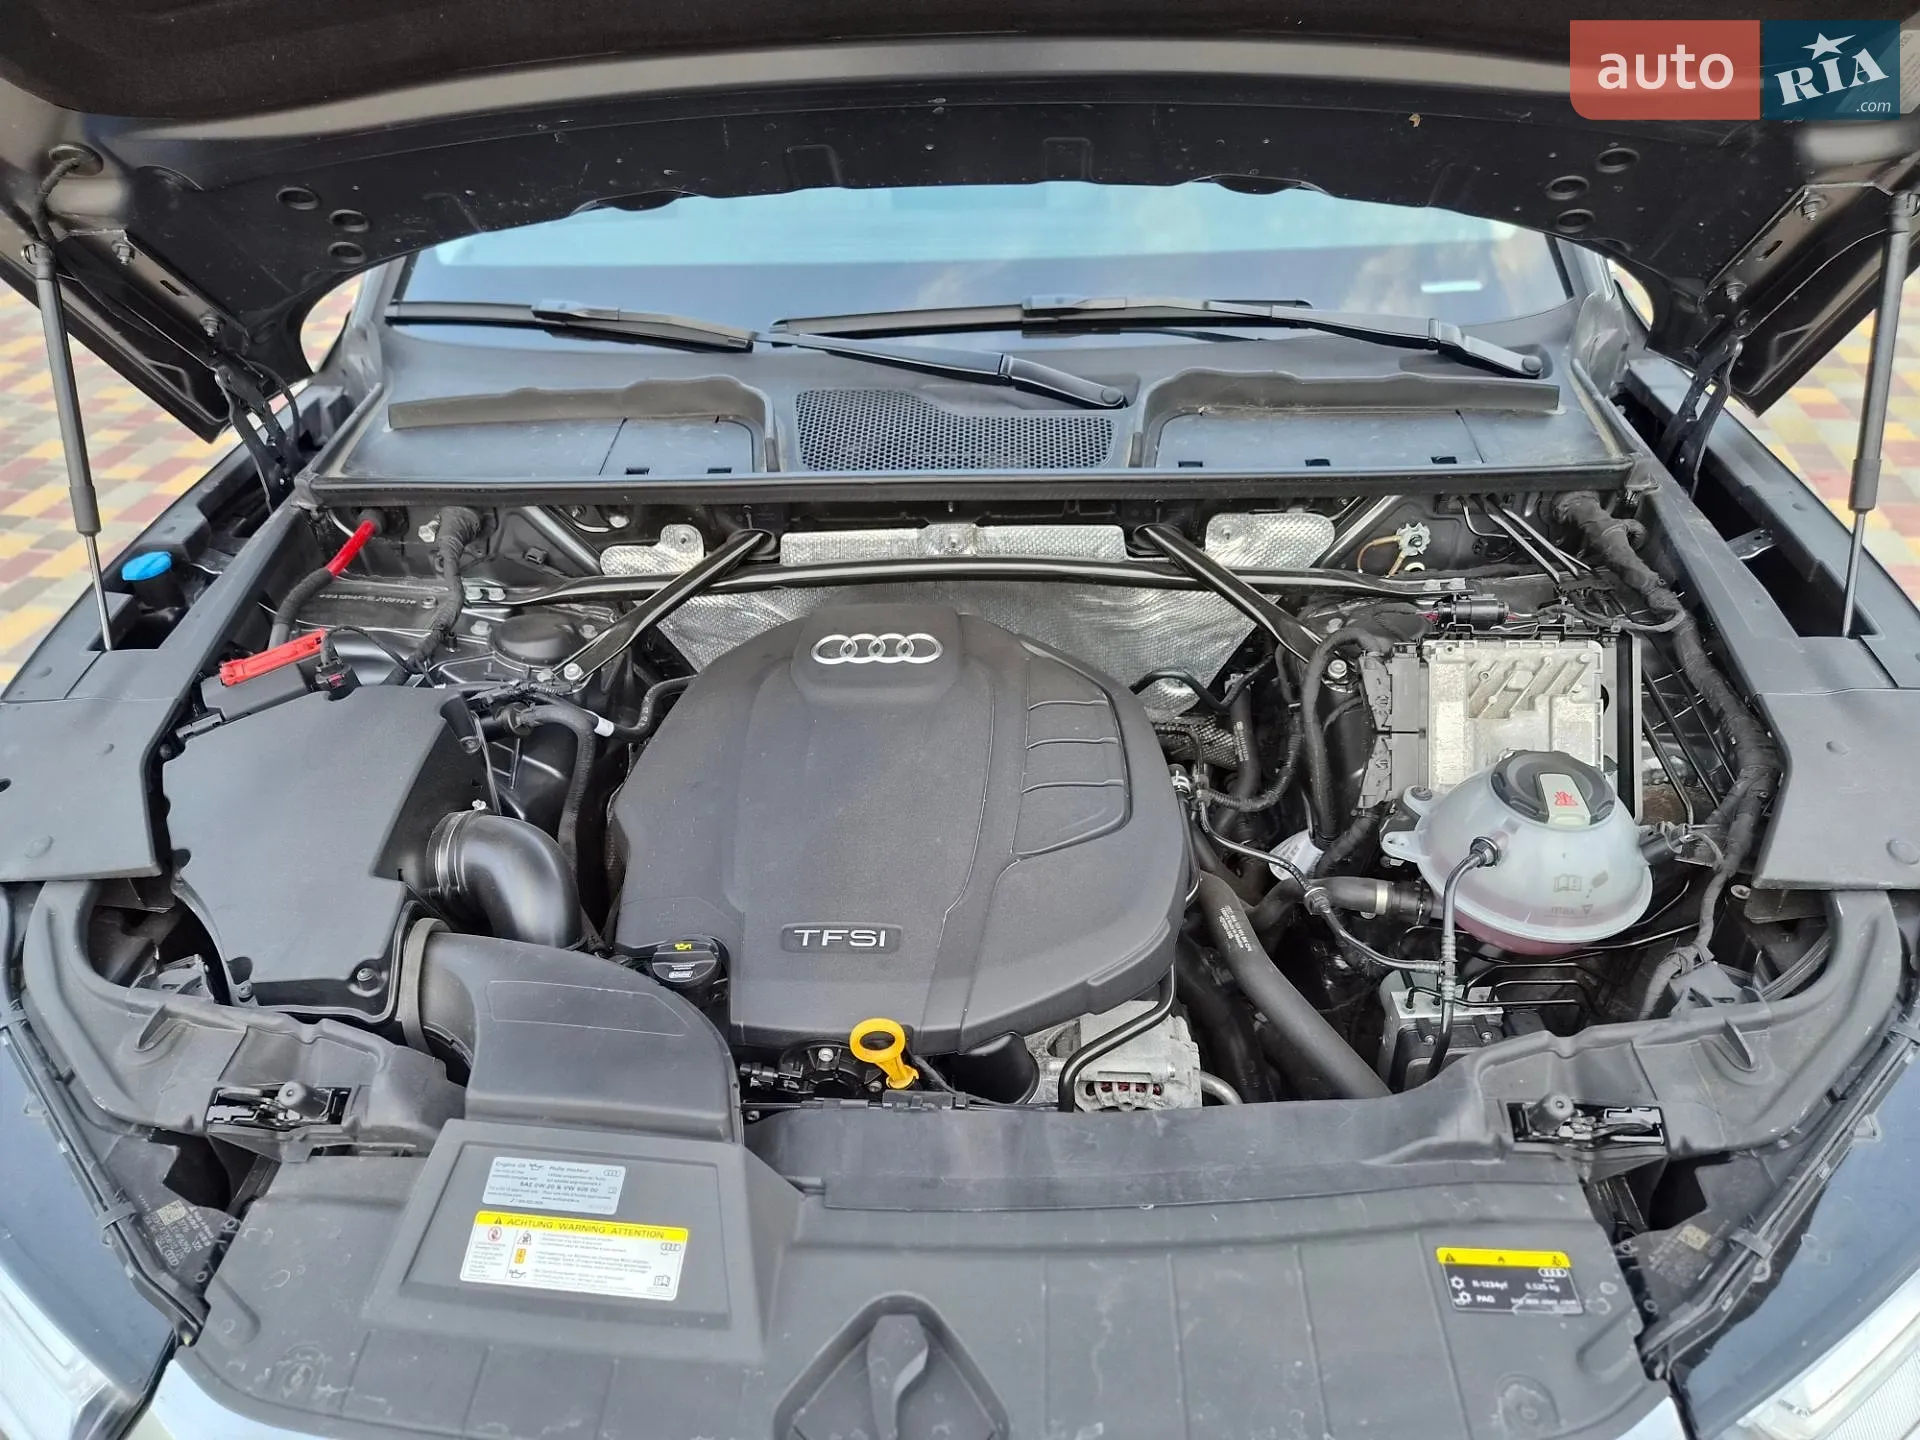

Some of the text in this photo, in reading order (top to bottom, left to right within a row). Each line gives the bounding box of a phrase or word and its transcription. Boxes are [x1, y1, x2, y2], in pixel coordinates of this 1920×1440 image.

[794, 929, 886, 948] TFSI
[507, 1217, 665, 1240] ACHTUNG WARNING ATTENTION
